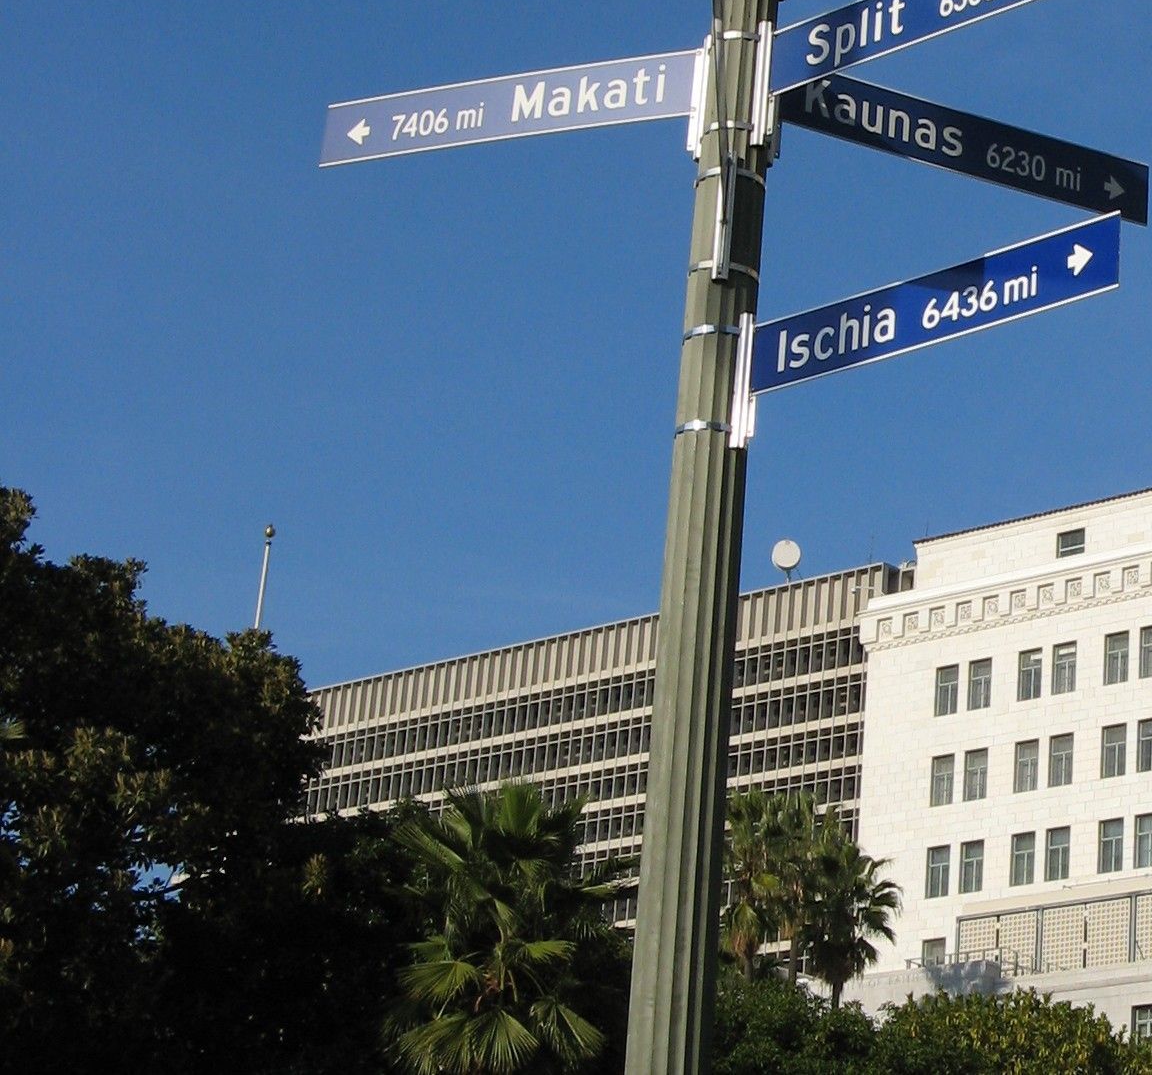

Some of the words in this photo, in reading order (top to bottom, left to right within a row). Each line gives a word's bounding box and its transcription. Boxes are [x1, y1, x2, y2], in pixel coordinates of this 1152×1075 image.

[391, 108, 449, 140] 7406
[456, 101, 485, 131] mi
[510, 63, 667, 122] Makati
[804, 79, 963, 157] Kaunas
[985, 143, 1046, 182] 6230
[1054, 165, 1082, 192] mi
[776, 304, 896, 374] Ischia
[920, 279, 998, 331] 6436
[1003, 265, 1038, 305] mi
